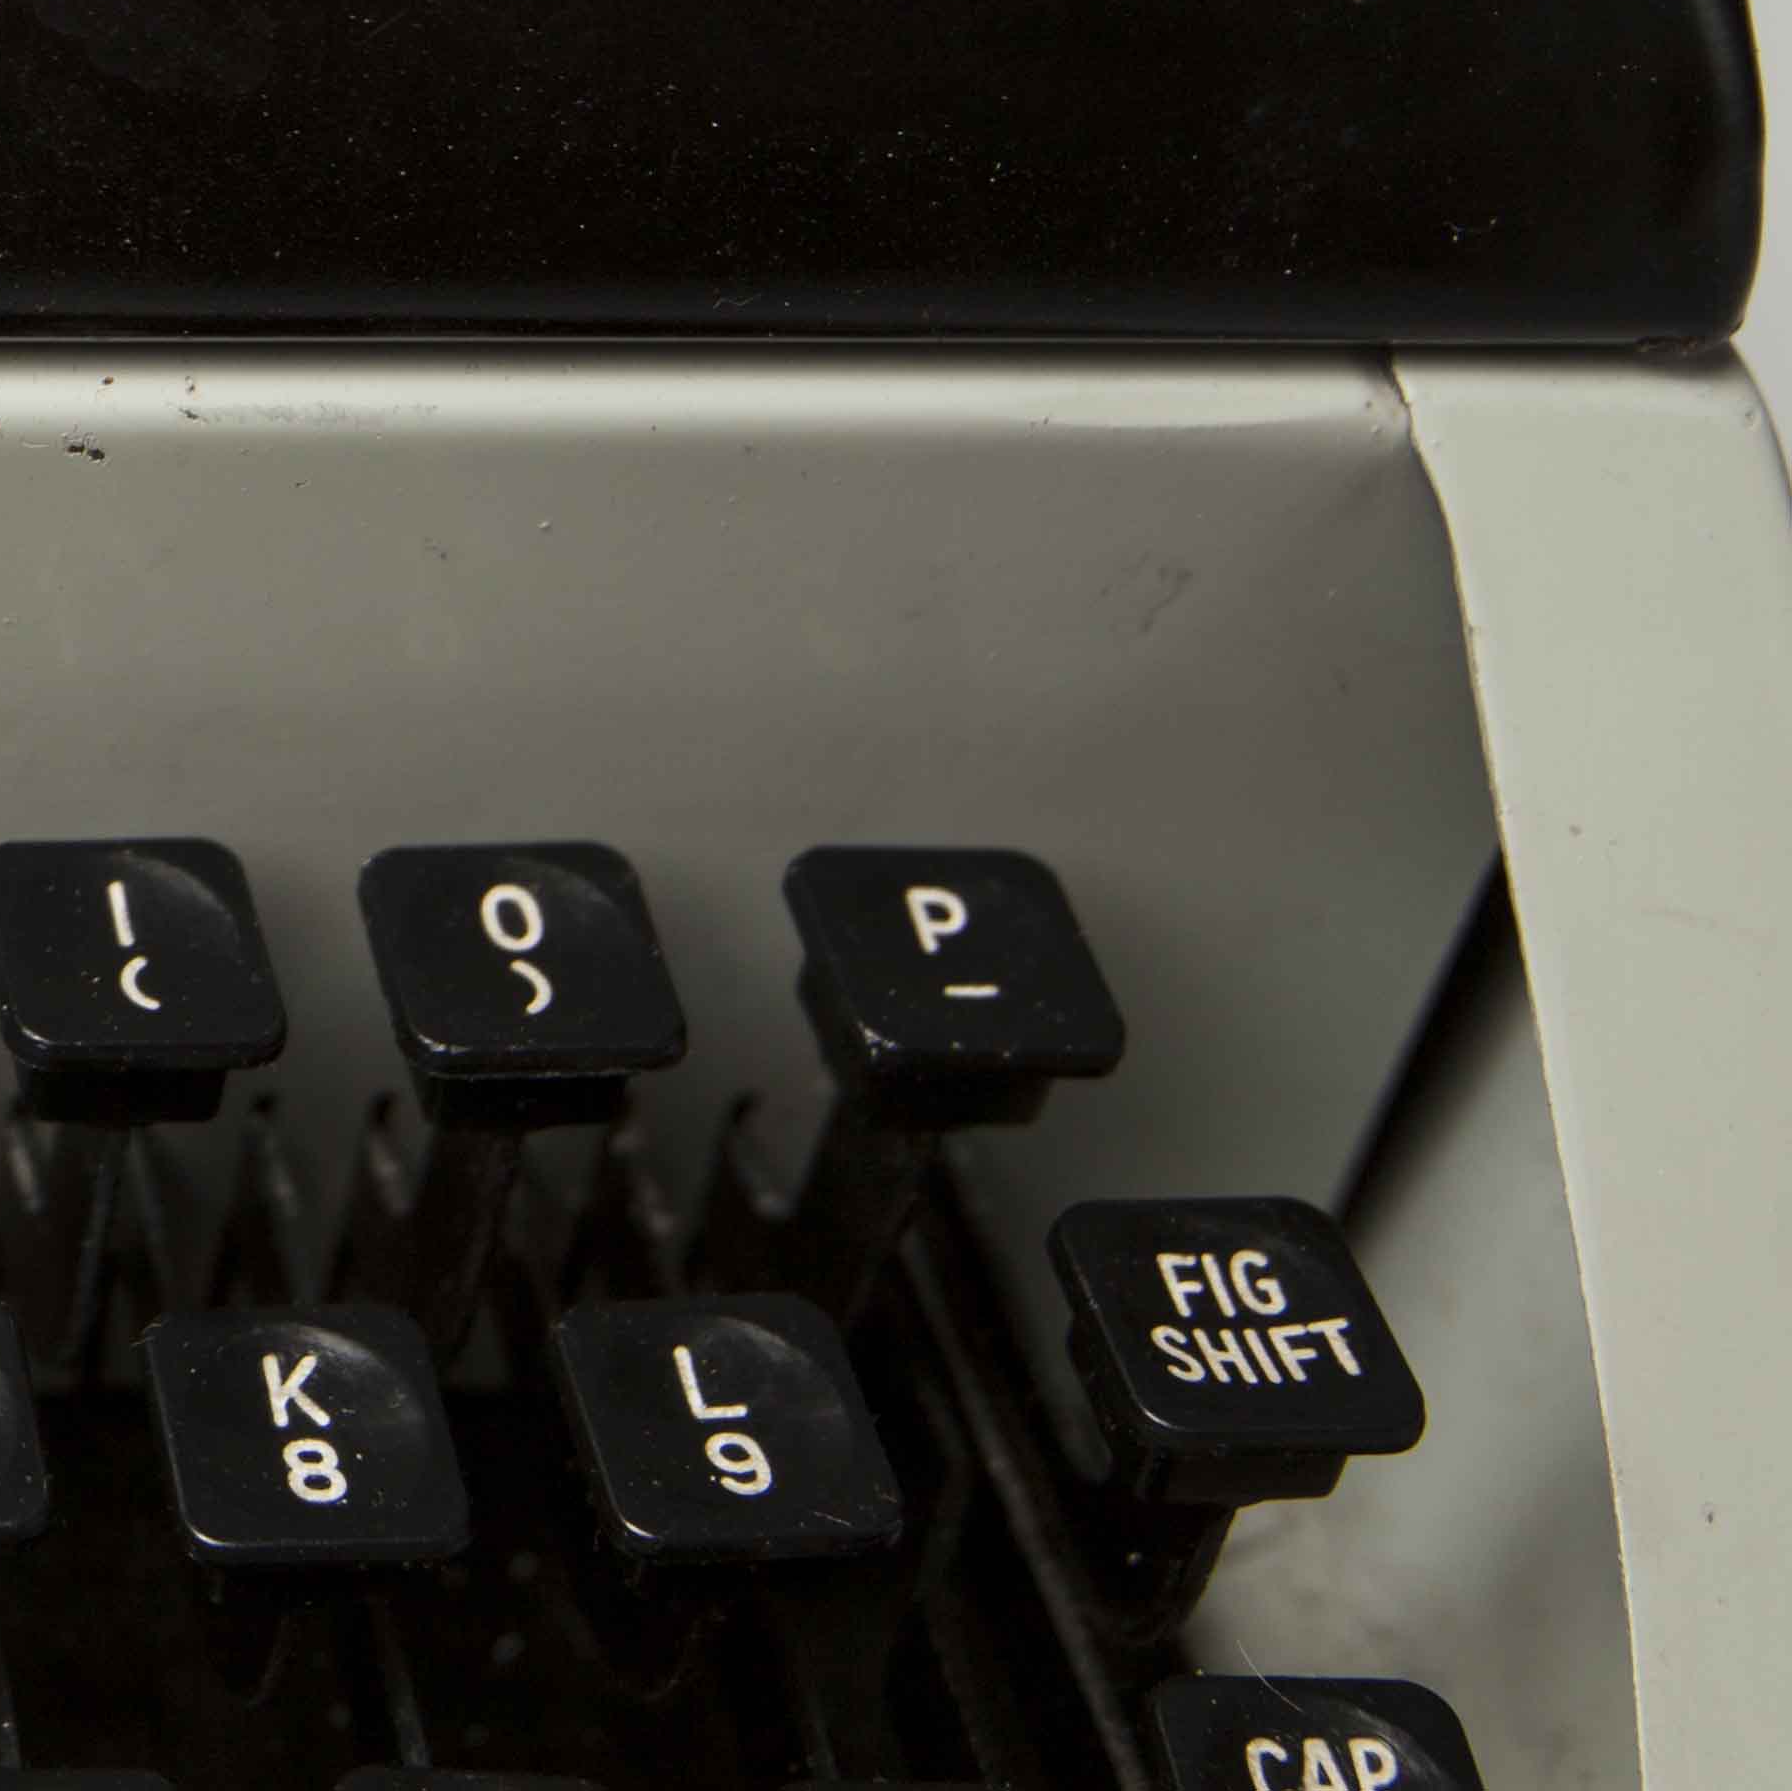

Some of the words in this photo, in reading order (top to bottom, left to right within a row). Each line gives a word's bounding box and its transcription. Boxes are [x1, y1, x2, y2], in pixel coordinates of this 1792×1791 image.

[108, 881, 136, 948] I
[481, 885, 544, 952] O
[907, 888, 967, 953] P
[1154, 1246, 1289, 1320] FIG
[673, 1346, 749, 1421] L
[1149, 1315, 1363, 1386] SHIFT
[262, 1354, 332, 1429] K
[282, 1438, 348, 1504] 8
[706, 1432, 773, 1496] 9
[1244, 1736, 1399, 1791] CAP
